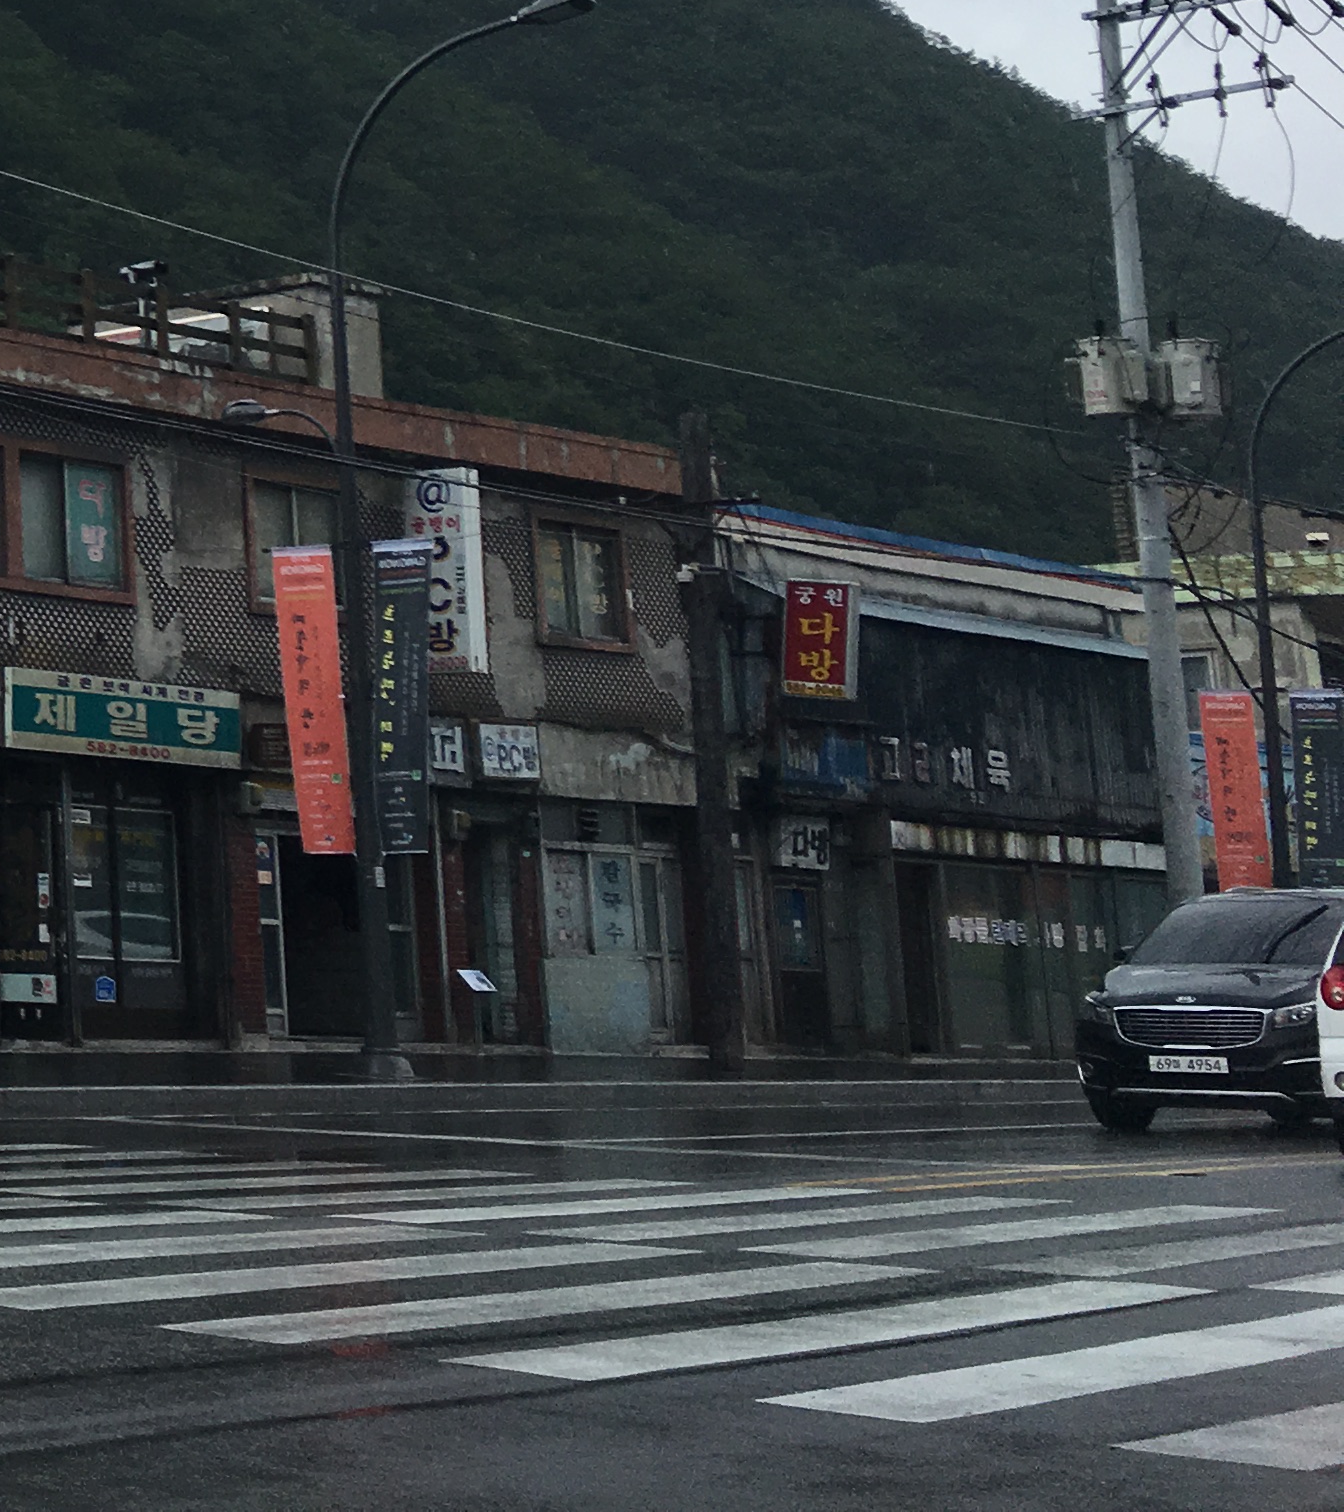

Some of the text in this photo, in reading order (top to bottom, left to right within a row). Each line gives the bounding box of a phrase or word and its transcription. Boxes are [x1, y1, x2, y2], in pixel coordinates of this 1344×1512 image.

[797, 610, 842, 681] 다방
[32, 692, 222, 746] 제일당
[1187, 1058, 1222, 1071] 4954
